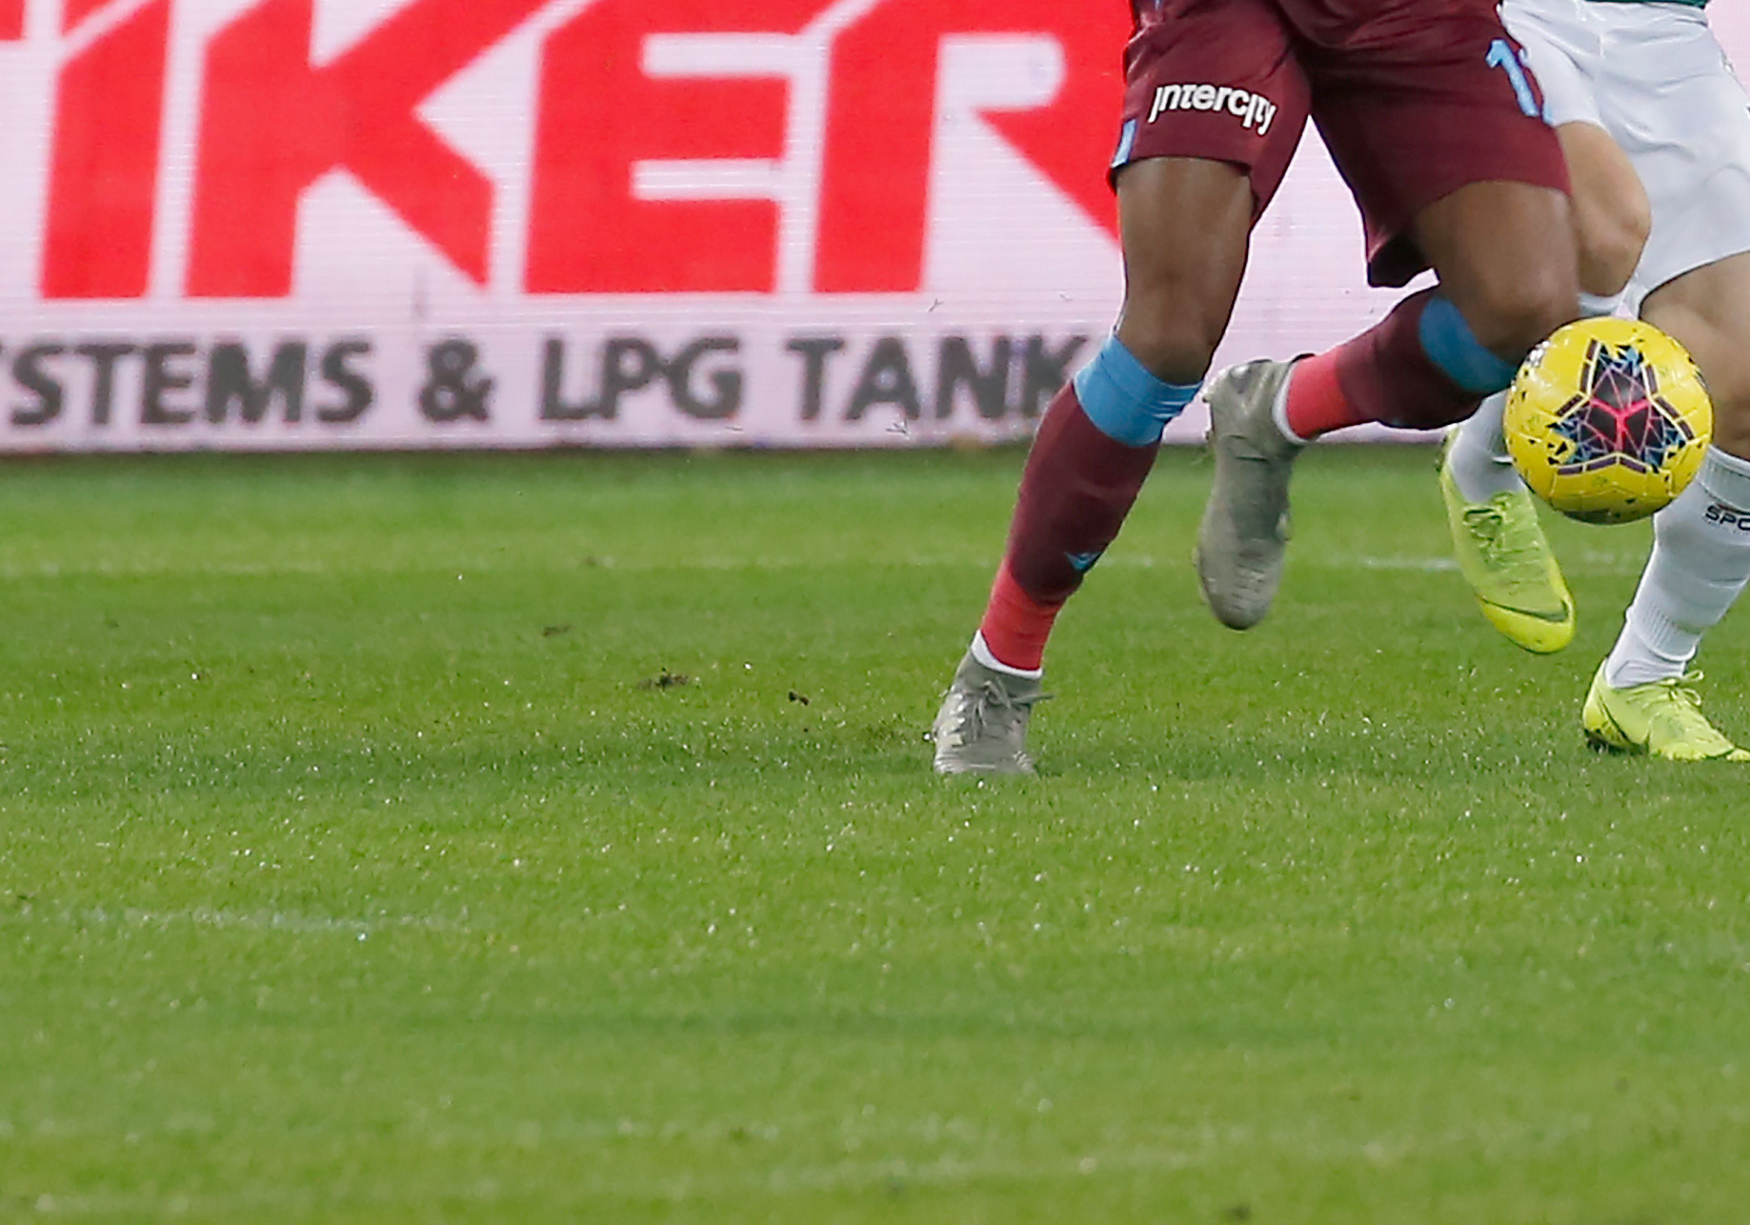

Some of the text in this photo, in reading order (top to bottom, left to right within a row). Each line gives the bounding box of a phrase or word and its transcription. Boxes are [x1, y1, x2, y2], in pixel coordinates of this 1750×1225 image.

[0, 339, 373, 426] STEMS
[416, 338, 494, 423] &
[538, 335, 744, 425] LPG
